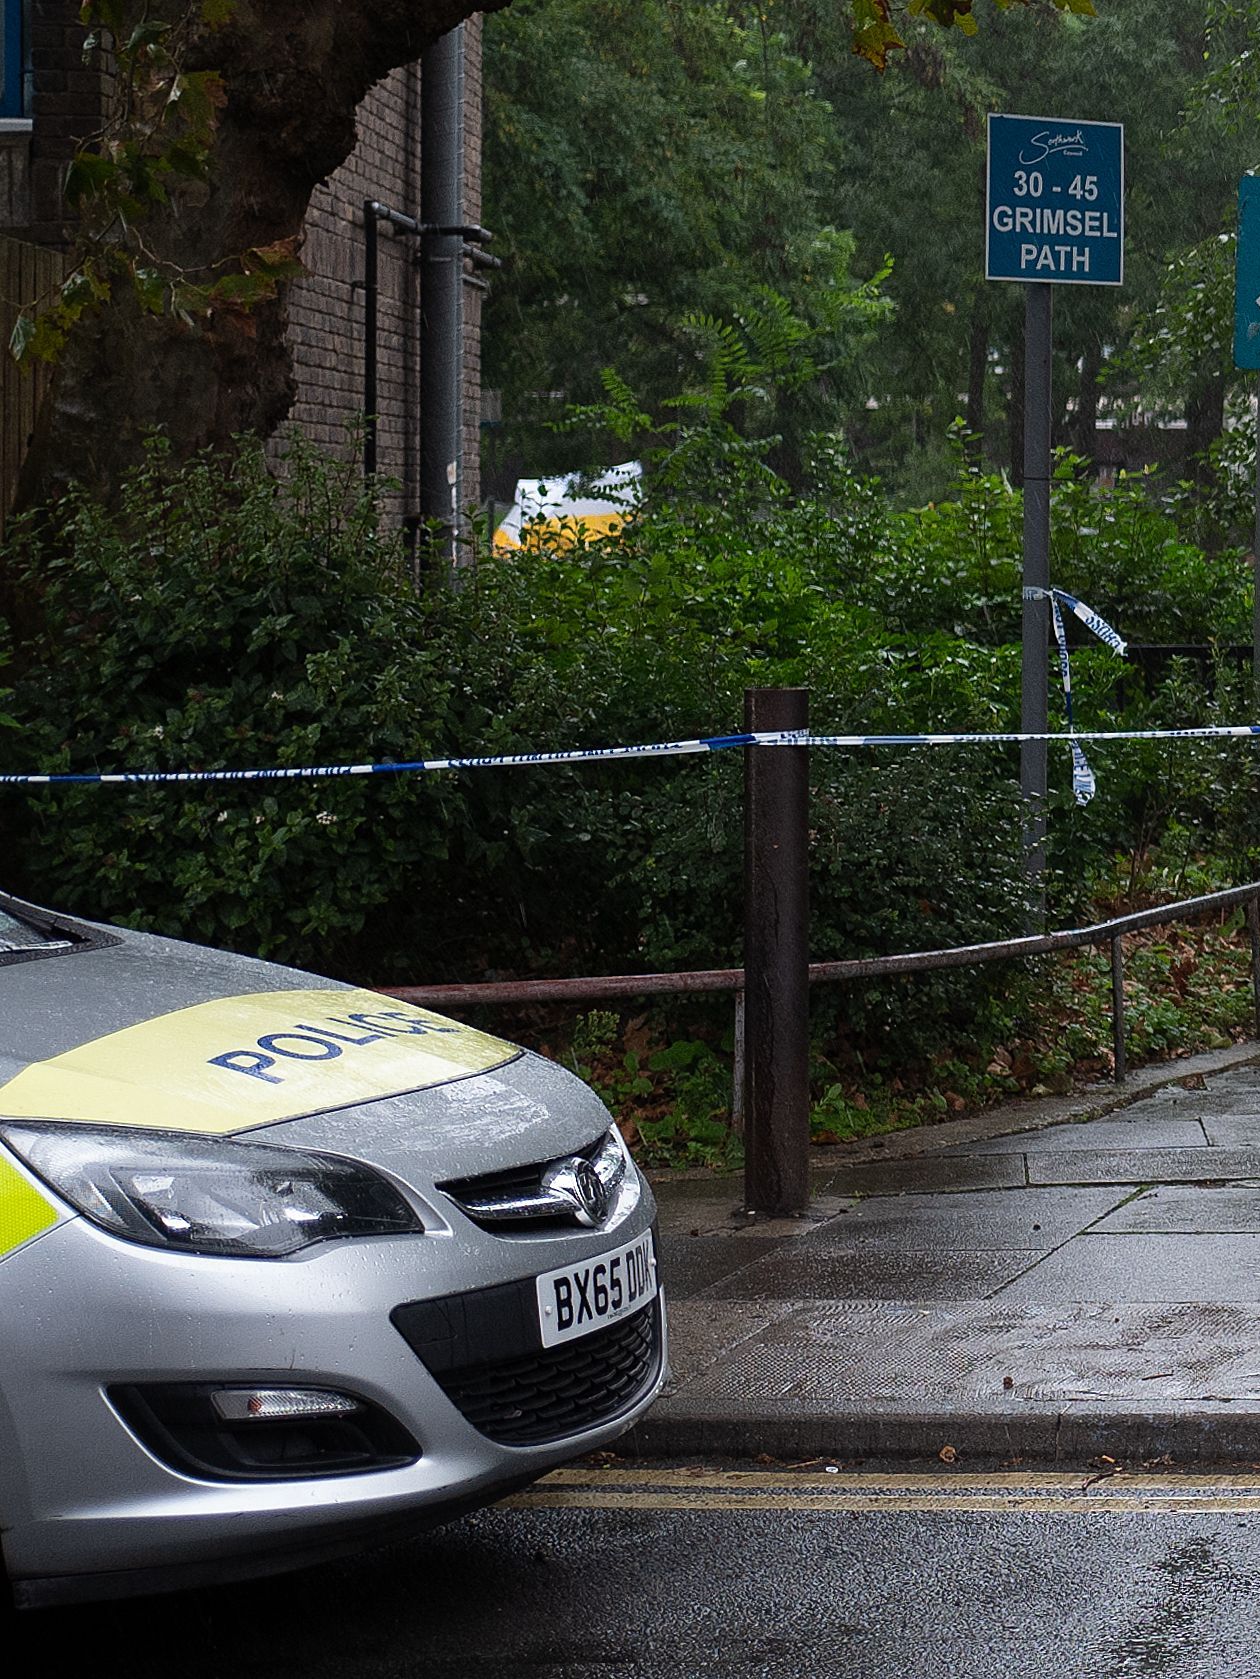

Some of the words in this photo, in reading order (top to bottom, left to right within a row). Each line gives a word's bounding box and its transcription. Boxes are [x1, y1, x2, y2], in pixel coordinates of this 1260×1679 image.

[1013, 170, 1043, 198] 30
[1068, 174, 1099, 201] 45
[992, 205, 1118, 238] GRIMSEL
[1020, 243, 1090, 273] PATH
[206, 1011, 460, 1085] POLICE
[553, 1257, 623, 1332] BX65
[625, 1239, 653, 1303] DDK
